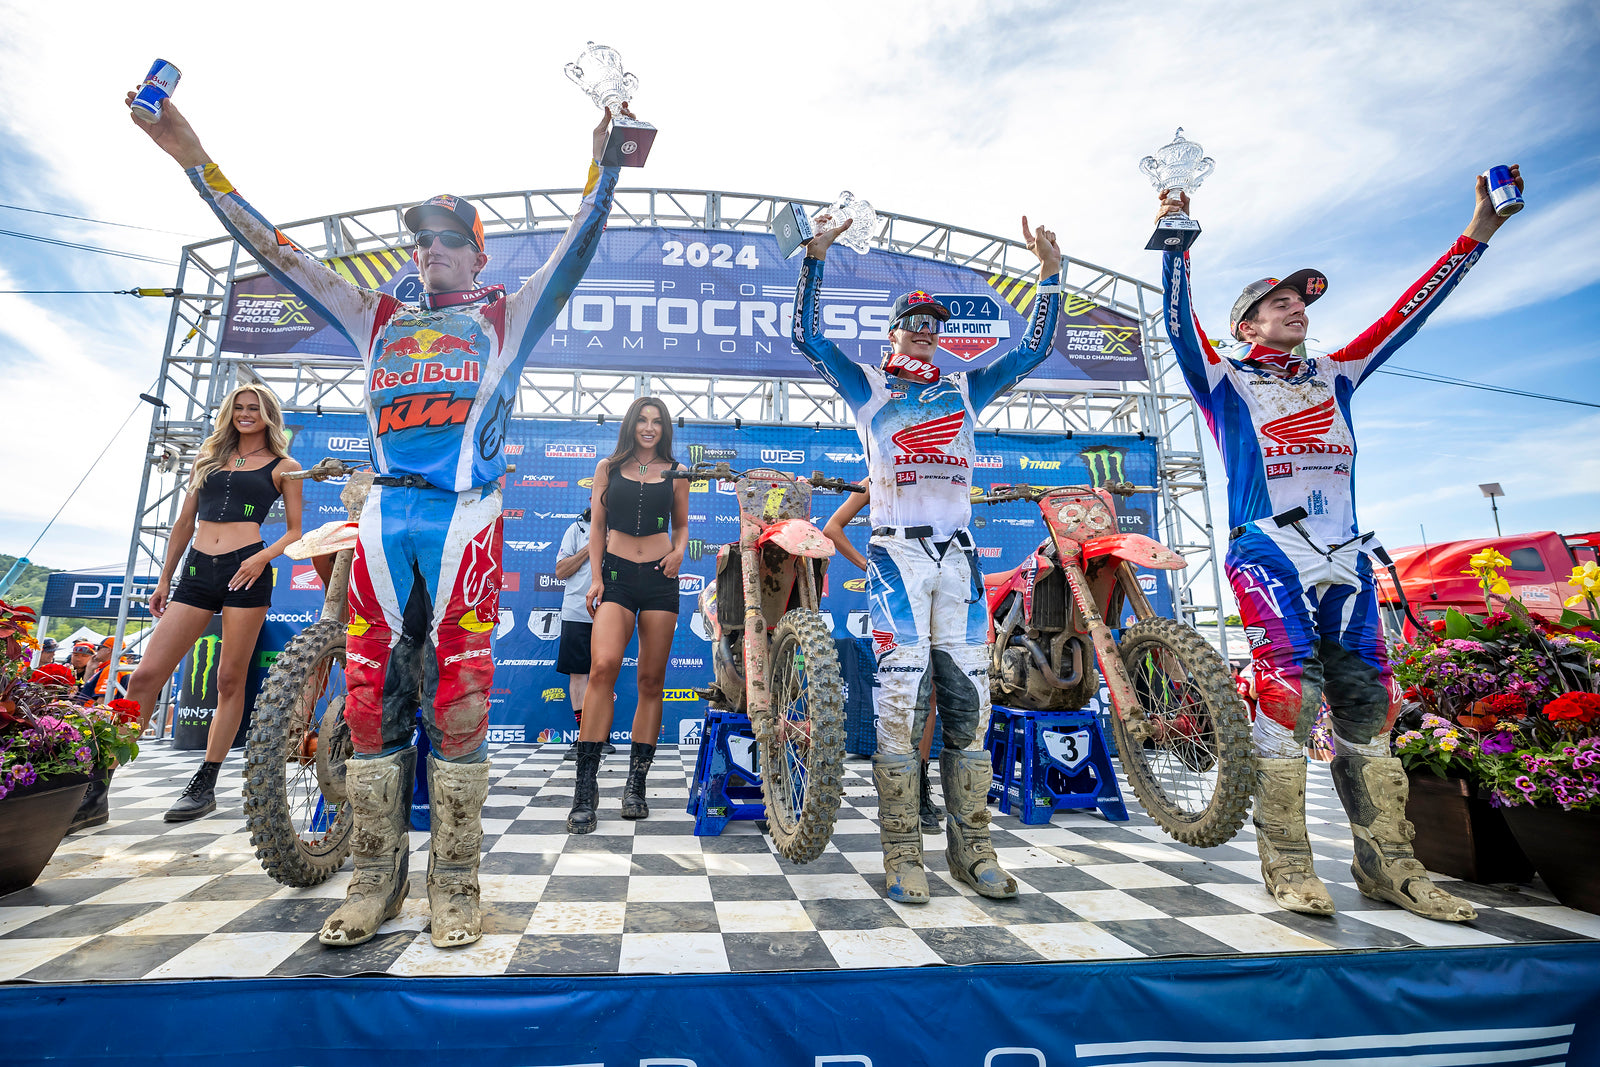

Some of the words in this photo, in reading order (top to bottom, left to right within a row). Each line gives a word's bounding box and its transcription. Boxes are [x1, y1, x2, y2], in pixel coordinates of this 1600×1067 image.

[661, 240, 760, 270] 2024
[661, 280, 757, 297] PRO
[1398, 252, 1468, 317] HONDA
[236, 300, 284, 308] SUPER
[792, 264, 810, 344] alpinestars
[1168, 256, 1182, 338] alpinestars
[238, 307, 281, 316] MOTO
[938, 300, 992, 317] 024
[233, 314, 280, 323] CROSS
[556, 295, 891, 341] OTOCRSS
[233, 325, 261, 333] WORLD
[261, 325, 315, 333] CHAMPIONSHIP
[943, 323, 961, 333] IGH
[962, 322, 992, 334] POINT
[1066, 329, 1105, 338] SUPER
[1069, 336, 1104, 345] MOTO
[1067, 344, 1105, 352] CROSS
[1092, 354, 1138, 362] CHAMPIONSHIP
[889, 353, 937, 380] 100%
[370, 361, 419, 392] Red
[422, 360, 480, 384] Bull
[377, 391, 476, 438] KTM
[546, 444, 596, 452] PARTS
[1264, 443, 1354, 458] HONDA
[761, 450, 805, 464] WPS
[894, 454, 970, 469] HONDA
[1029, 461, 1061, 470] THOR
[1268, 464, 1291, 475] ヨシムラ
[897, 472, 916, 483] ヨシムラ
[762, 487, 788, 518] 1
[1057, 503, 1112, 533] 96
[678, 658, 703, 666] YAMAHA
[542, 687, 564, 698] MOTO
[544, 691, 567, 703] TEES
[1060, 735, 1079, 762] 3
[747, 740, 758, 773] 1
